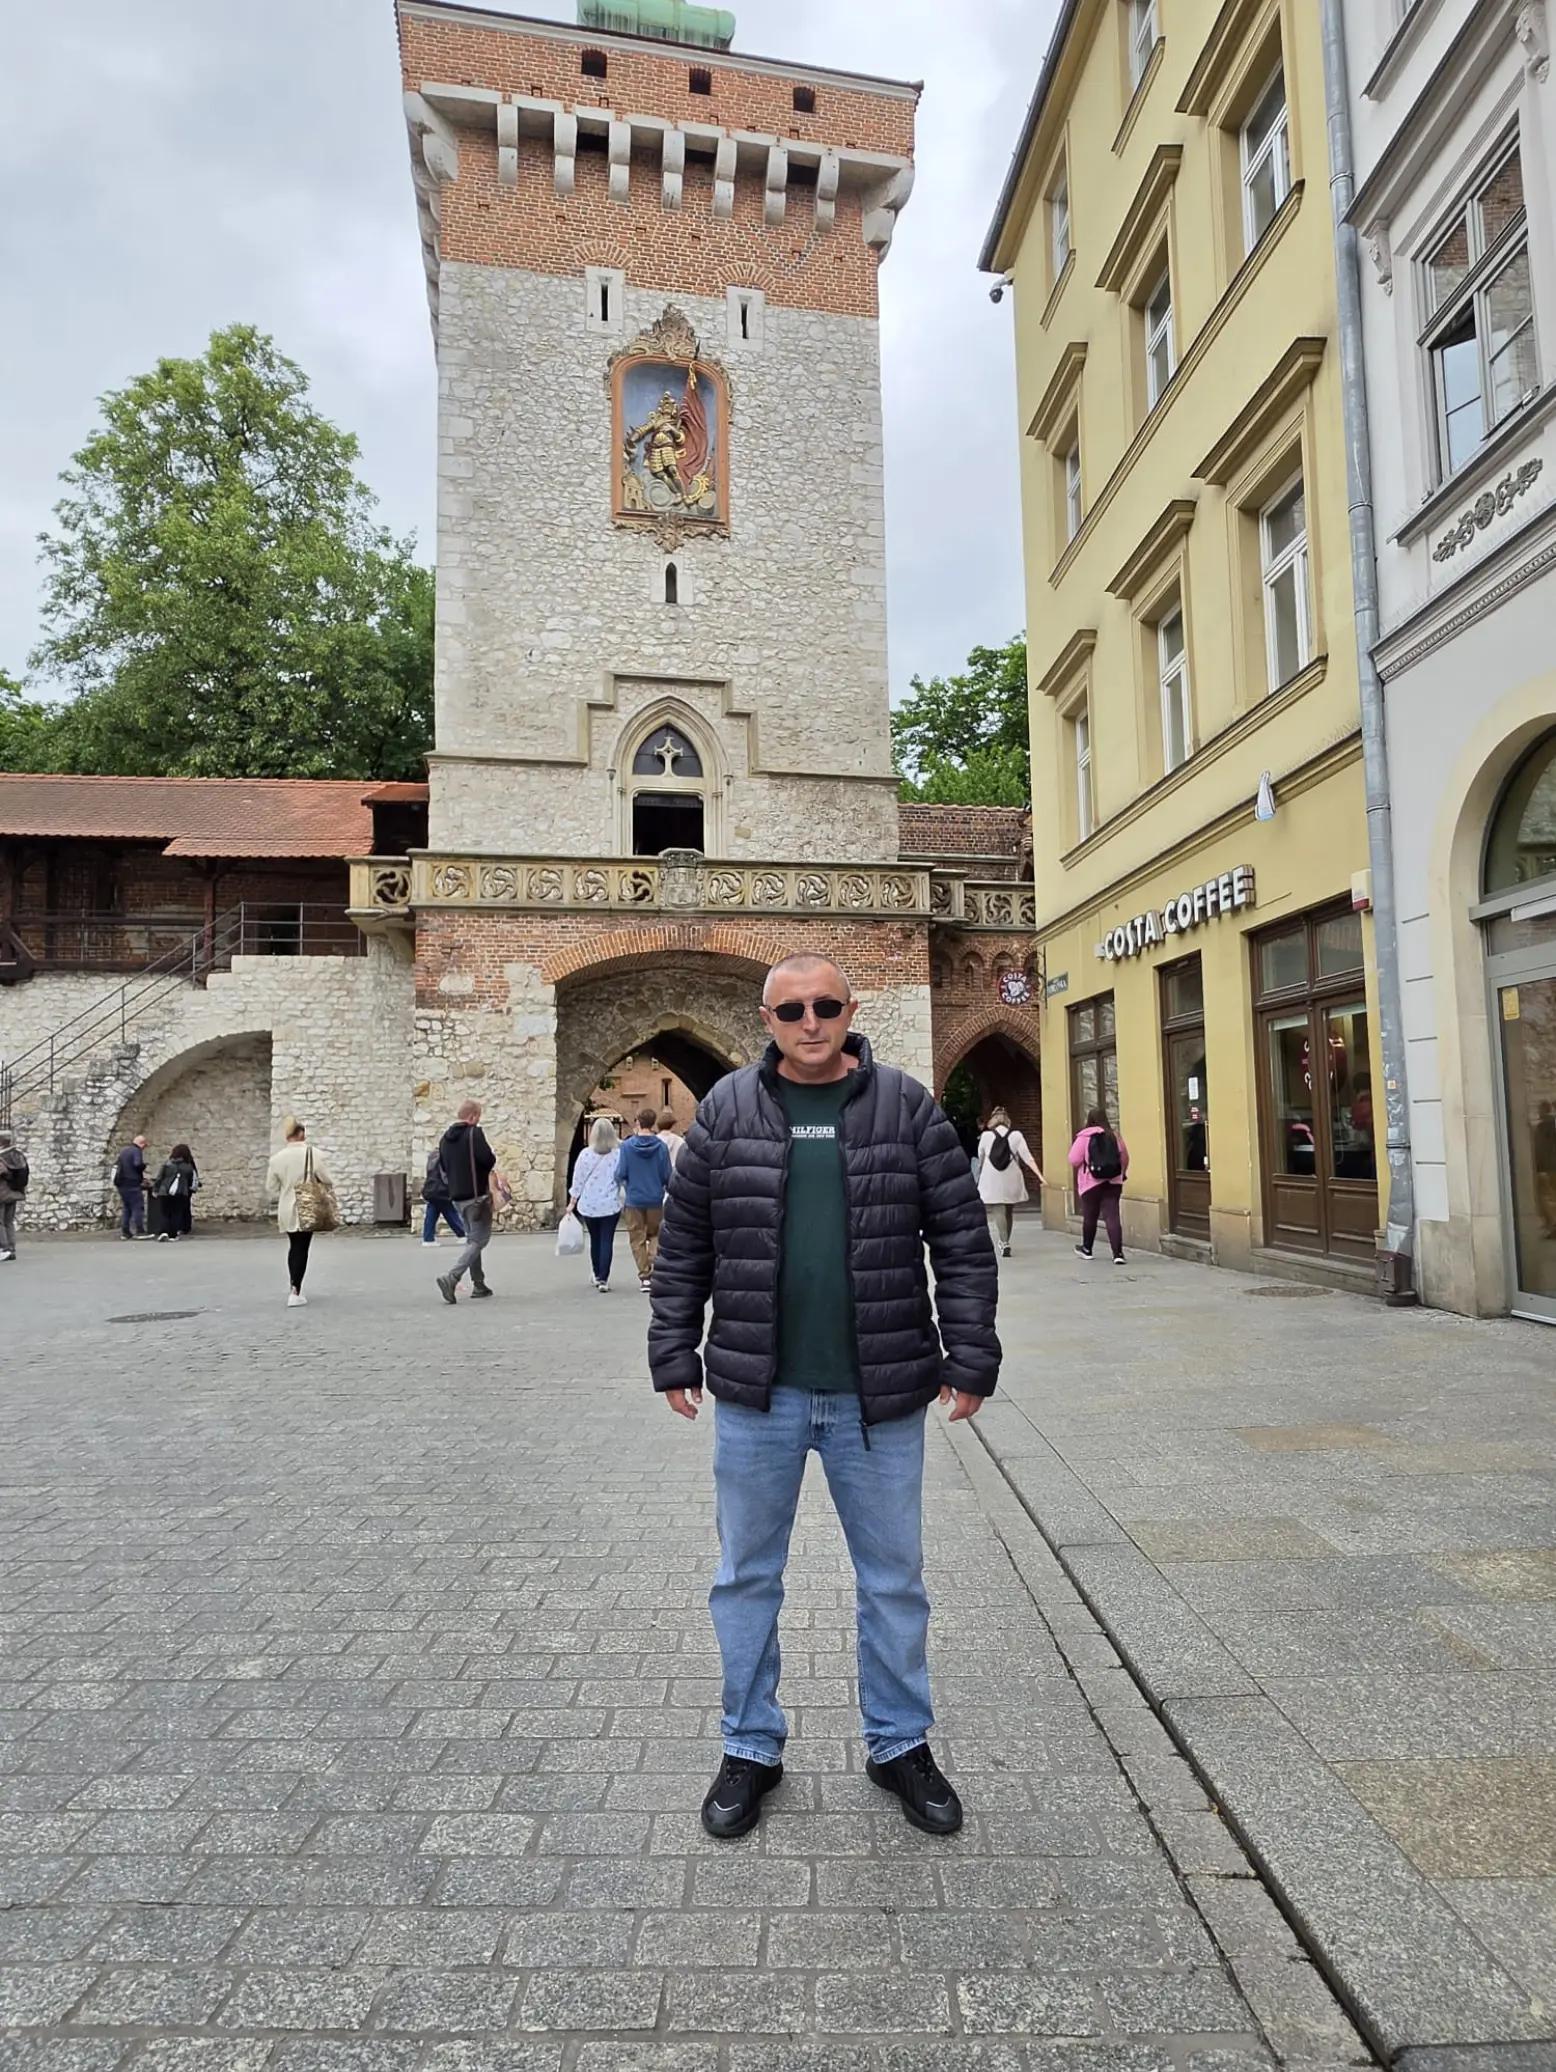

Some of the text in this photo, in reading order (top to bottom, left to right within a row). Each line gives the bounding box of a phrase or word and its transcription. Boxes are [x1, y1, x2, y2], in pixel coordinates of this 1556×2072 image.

[1105, 865, 1251, 960] COSTA COFFEE
[1003, 973, 1027, 983] COSTA
